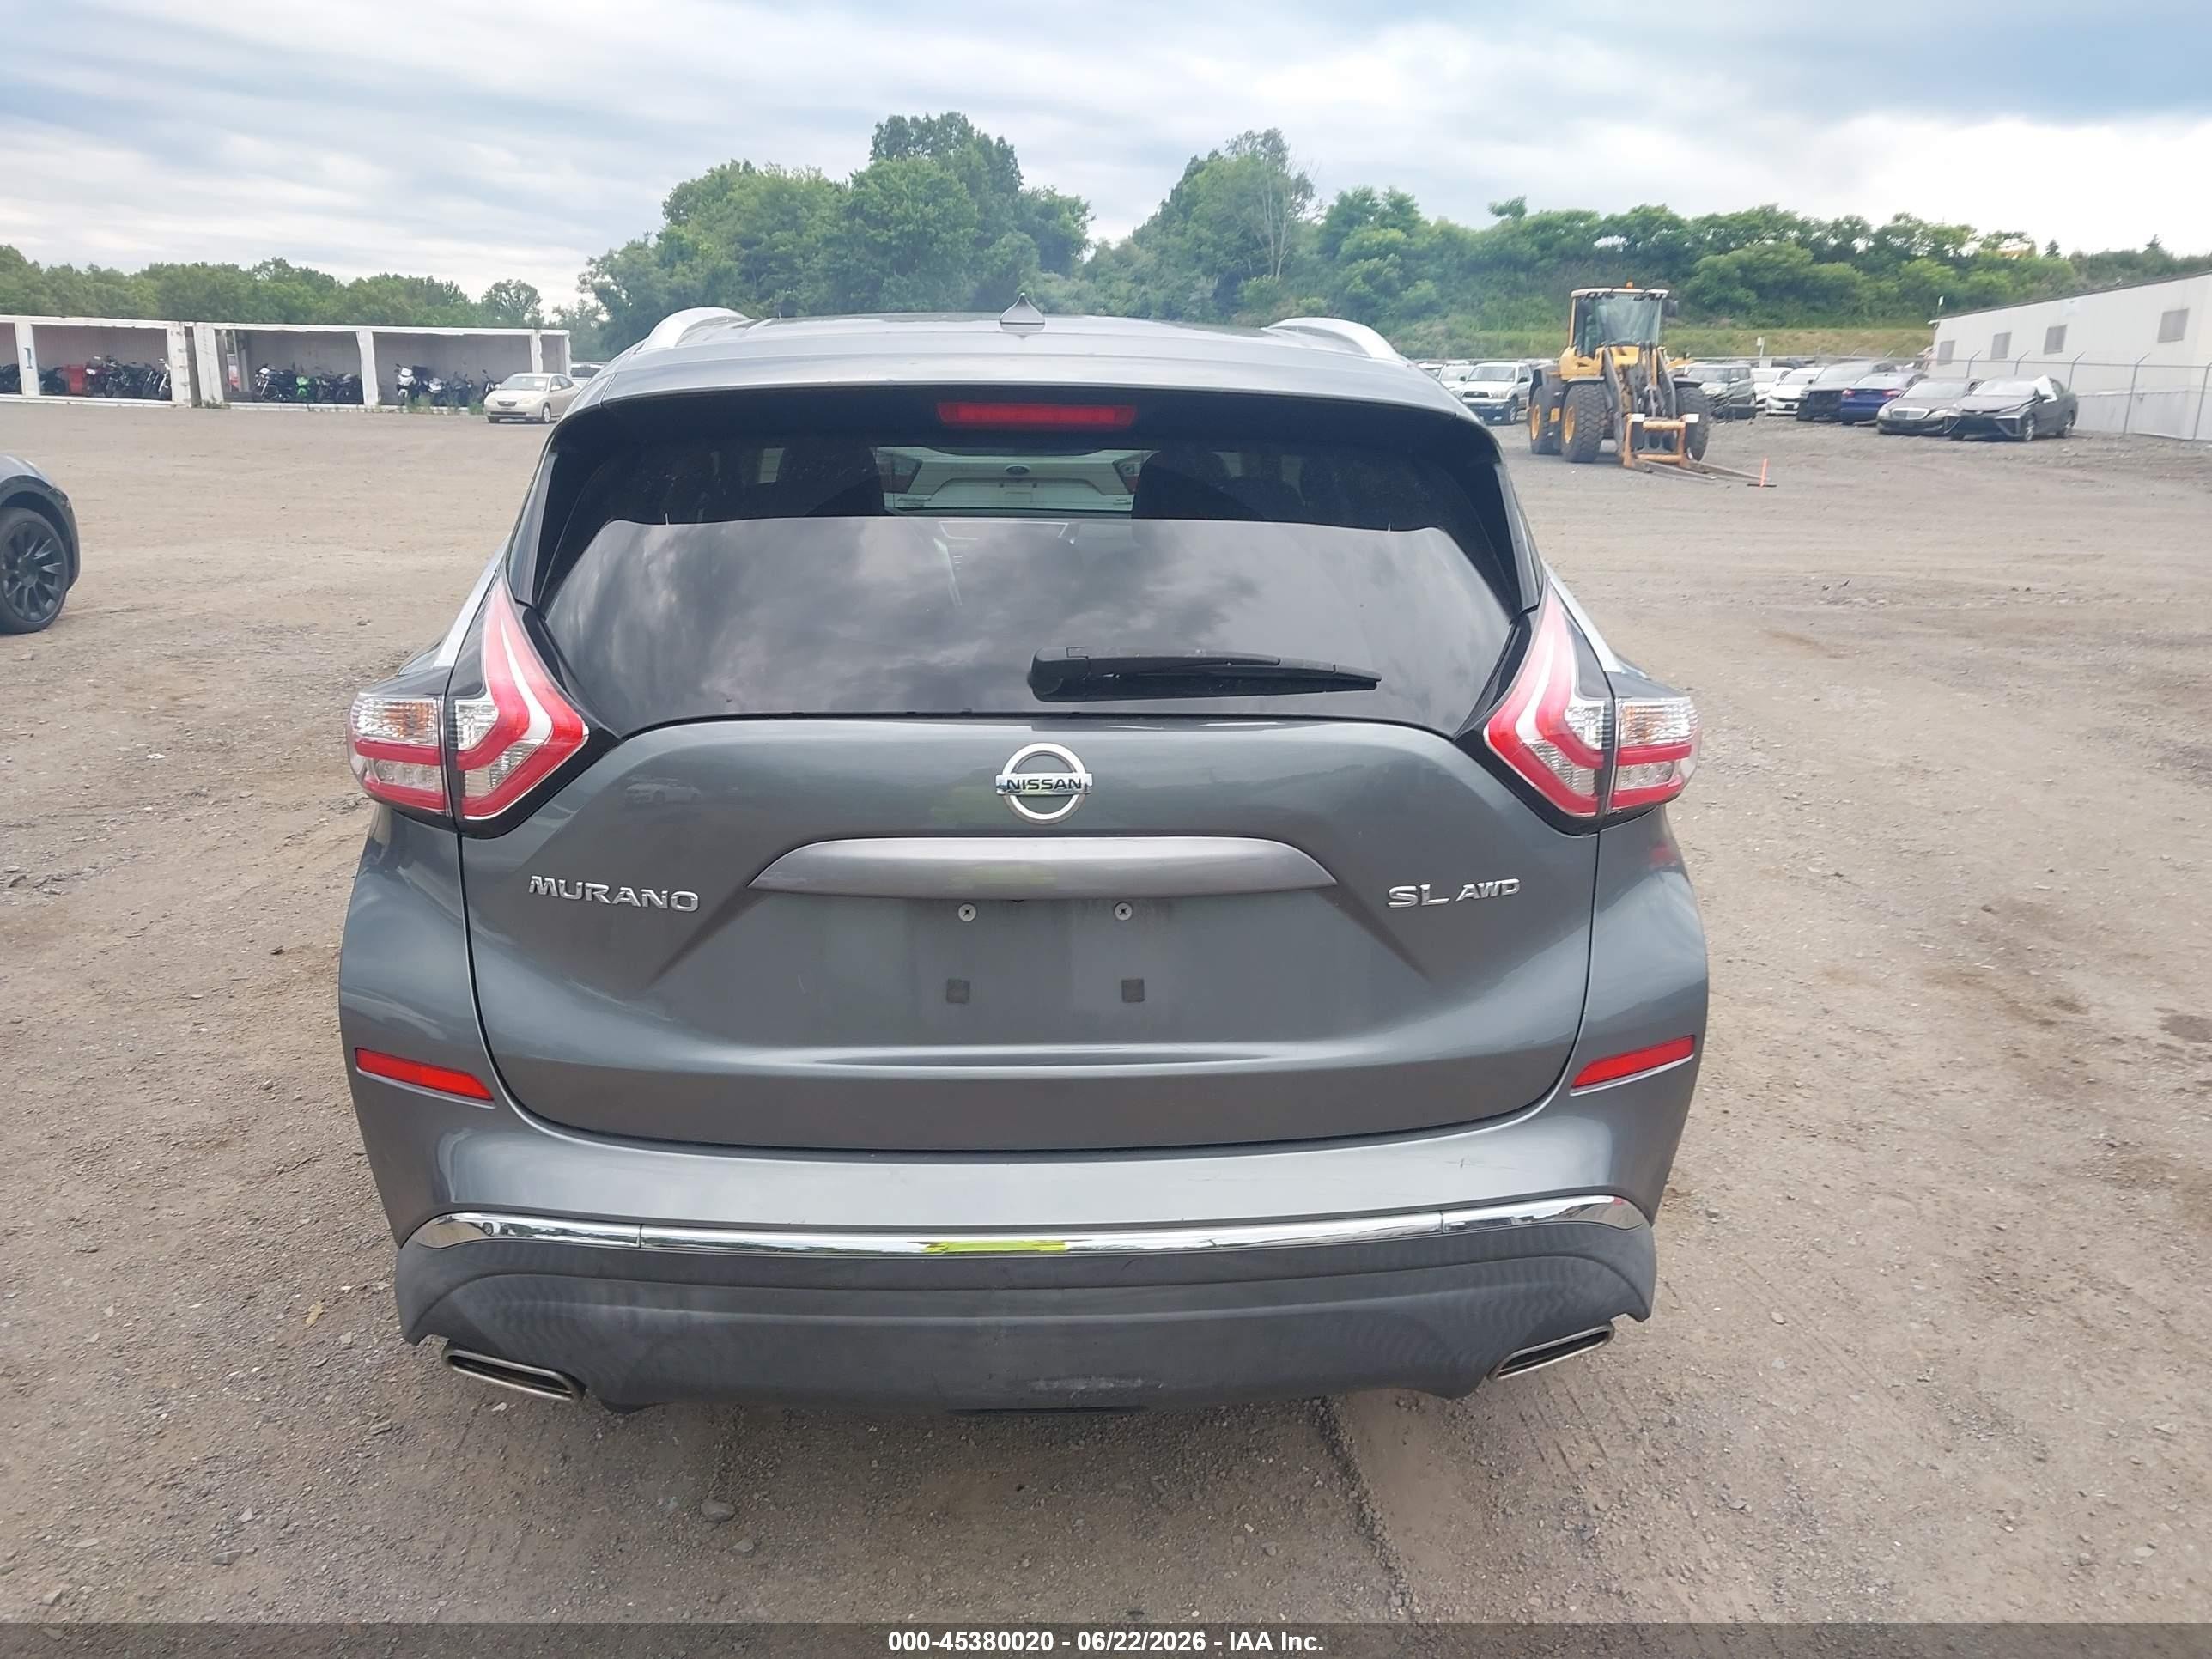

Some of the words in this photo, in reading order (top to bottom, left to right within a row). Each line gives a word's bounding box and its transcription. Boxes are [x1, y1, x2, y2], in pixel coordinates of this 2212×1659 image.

[1006, 778, 1081, 790] NISSAN
[528, 875, 699, 912] MURANO
[1388, 884, 1450, 908] SL
[1455, 878, 1520, 902] AWD
